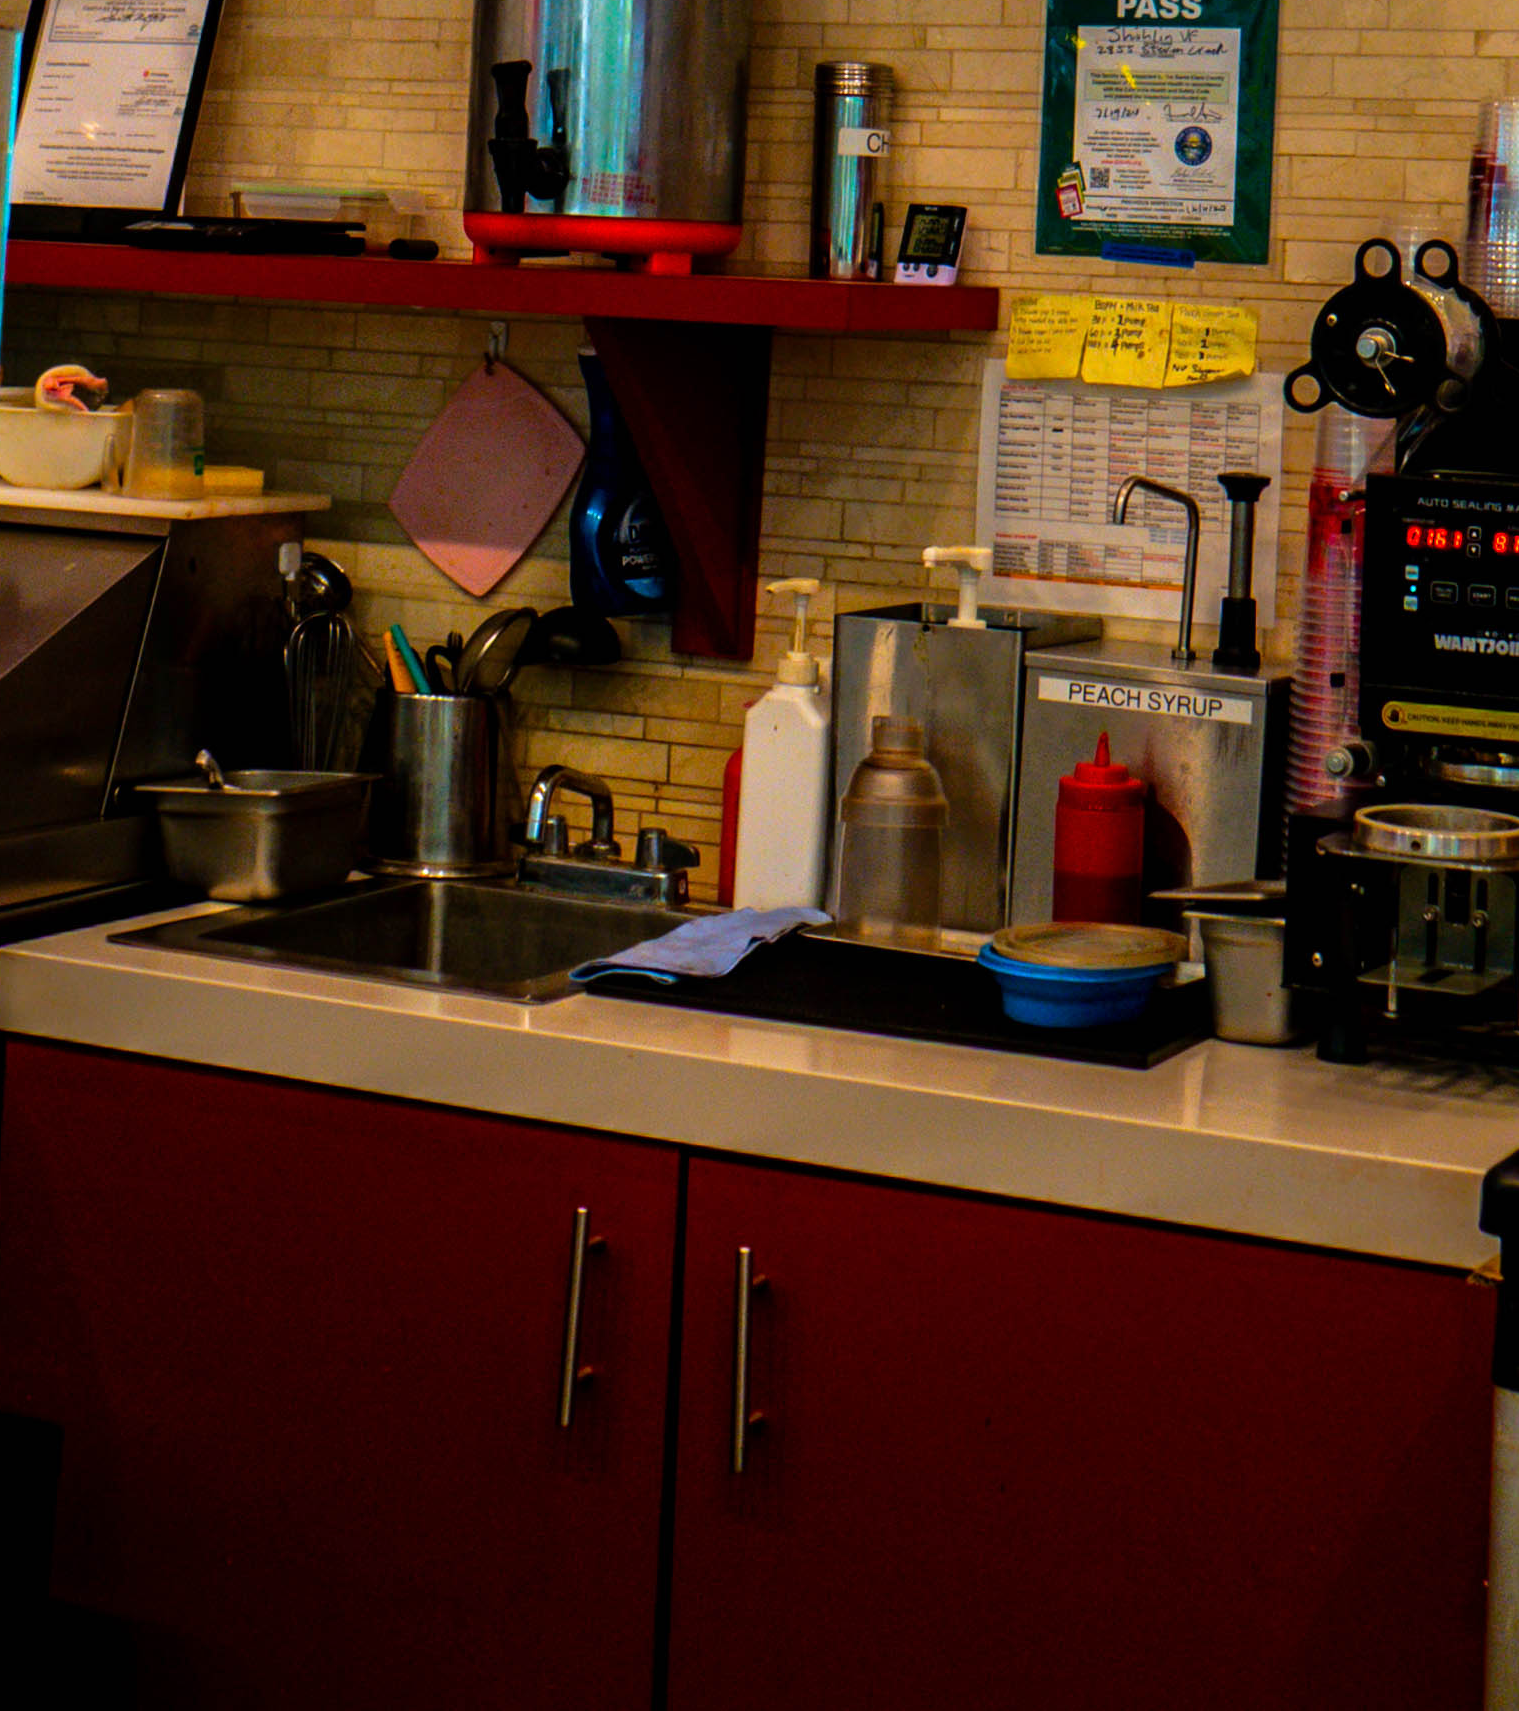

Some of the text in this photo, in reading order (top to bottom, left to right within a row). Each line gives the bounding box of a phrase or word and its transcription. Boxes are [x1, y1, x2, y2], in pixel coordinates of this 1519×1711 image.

[1418, 497, 1449, 508] AUTO
[1453, 499, 1502, 512] SEALING
[1068, 684, 1224, 717] PEACH SYRUP
